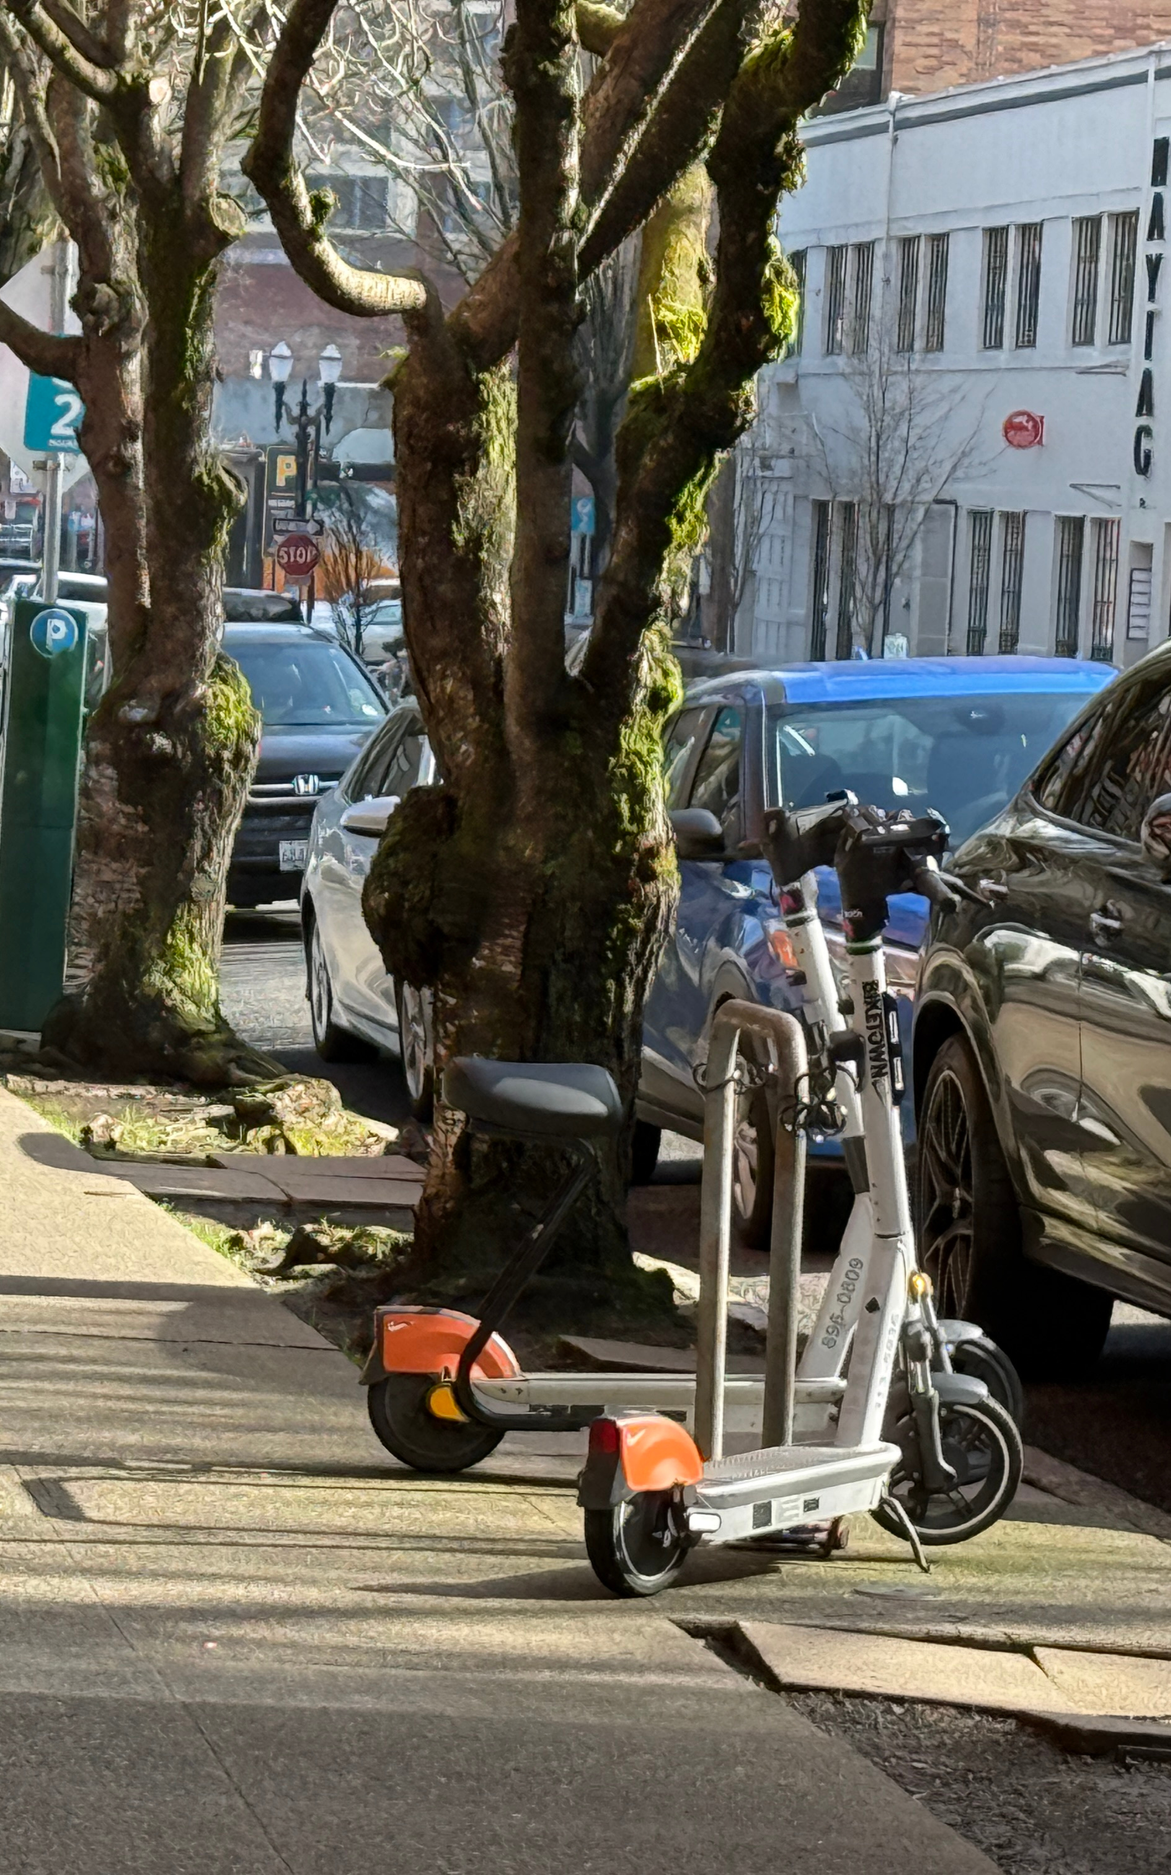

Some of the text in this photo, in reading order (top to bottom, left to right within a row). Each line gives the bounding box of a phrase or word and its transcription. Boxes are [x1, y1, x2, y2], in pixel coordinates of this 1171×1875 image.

[278, 546, 318, 564] STOP
[46, 618, 67, 653] P
[861, 979, 889, 1079] BIKETOWN
